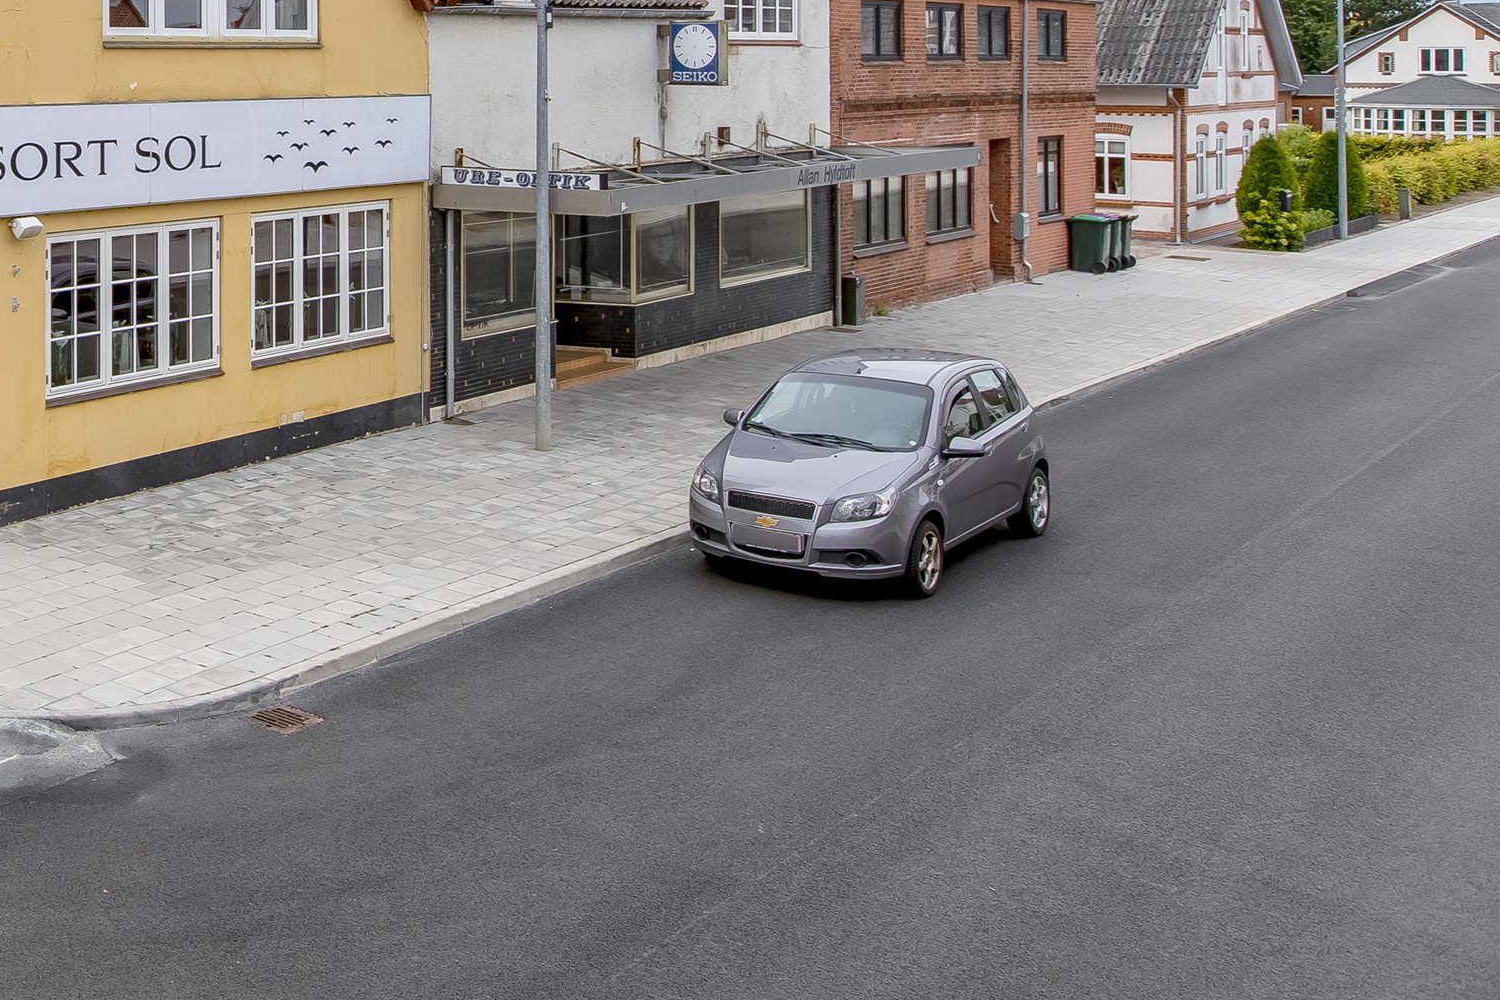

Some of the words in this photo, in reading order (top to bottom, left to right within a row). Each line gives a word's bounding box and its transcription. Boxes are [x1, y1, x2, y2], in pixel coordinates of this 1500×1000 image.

[672, 71, 718, 82] SEIKO
[134, 134, 222, 174] SOL
[796, 167, 820, 185] Allan
